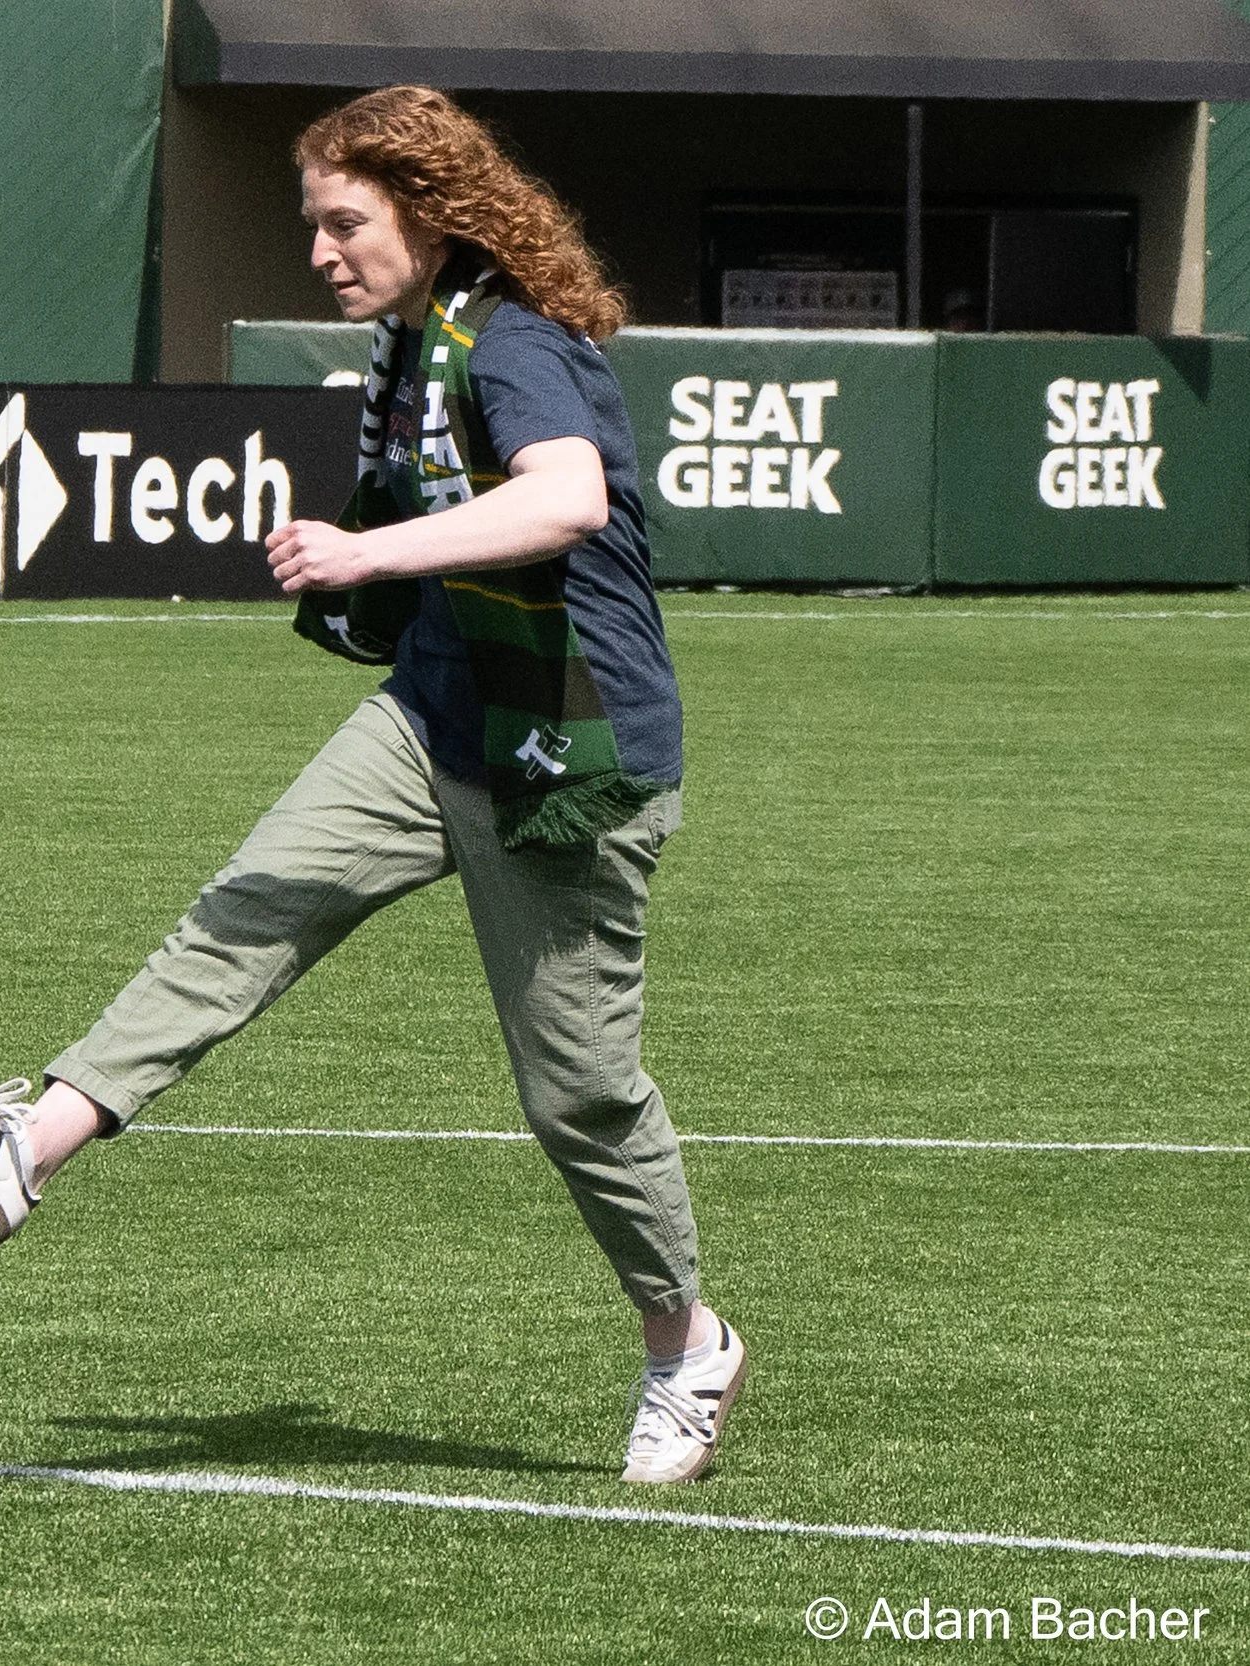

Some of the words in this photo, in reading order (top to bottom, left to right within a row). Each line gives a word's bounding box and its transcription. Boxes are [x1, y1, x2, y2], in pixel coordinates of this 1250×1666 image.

[668, 376, 838, 443] SEAT
[1046, 378, 1160, 444] SEAT
[78, 430, 292, 543] Tech
[657, 445, 842, 514] GEEK
[1038, 446, 1165, 510] GEEK
